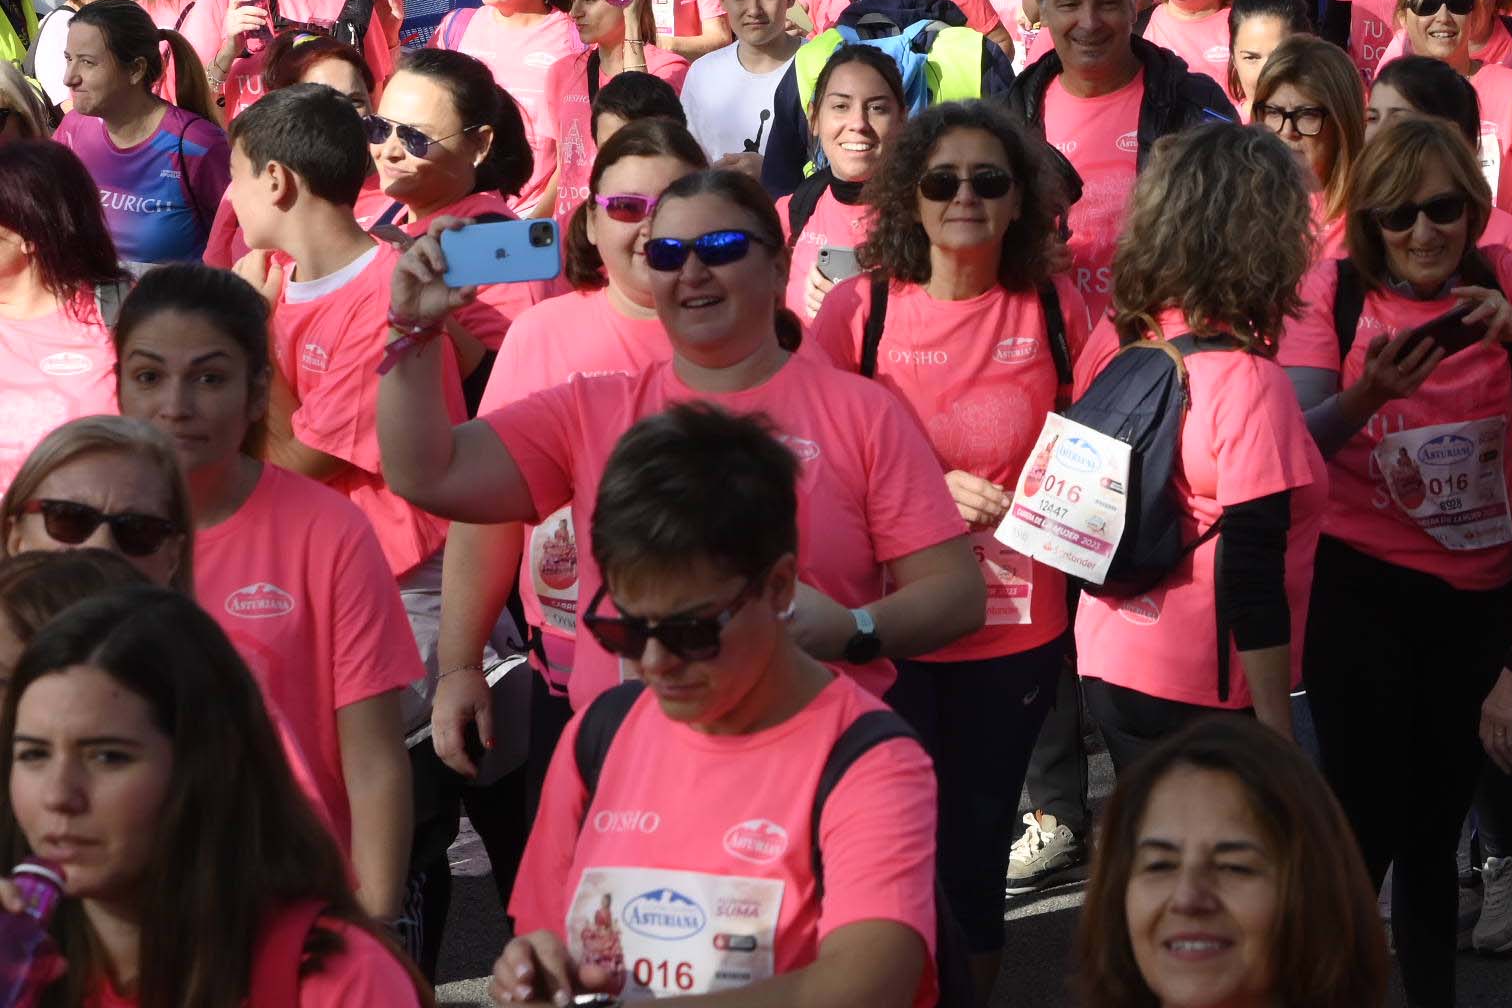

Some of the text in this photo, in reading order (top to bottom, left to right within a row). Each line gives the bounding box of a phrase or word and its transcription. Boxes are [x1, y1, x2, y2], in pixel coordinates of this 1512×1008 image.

[1363, 20, 1383, 38] TU
[236, 74, 263, 95] TU
[100, 189, 173, 214] ZURICH
[889, 350, 948, 366] OYSHO
[1044, 474, 1082, 504] 016
[1429, 473, 1468, 496] 016
[231, 598, 290, 612] ASTURIANA
[632, 907, 701, 930] ASTURIANA
[633, 958, 694, 991] 016
